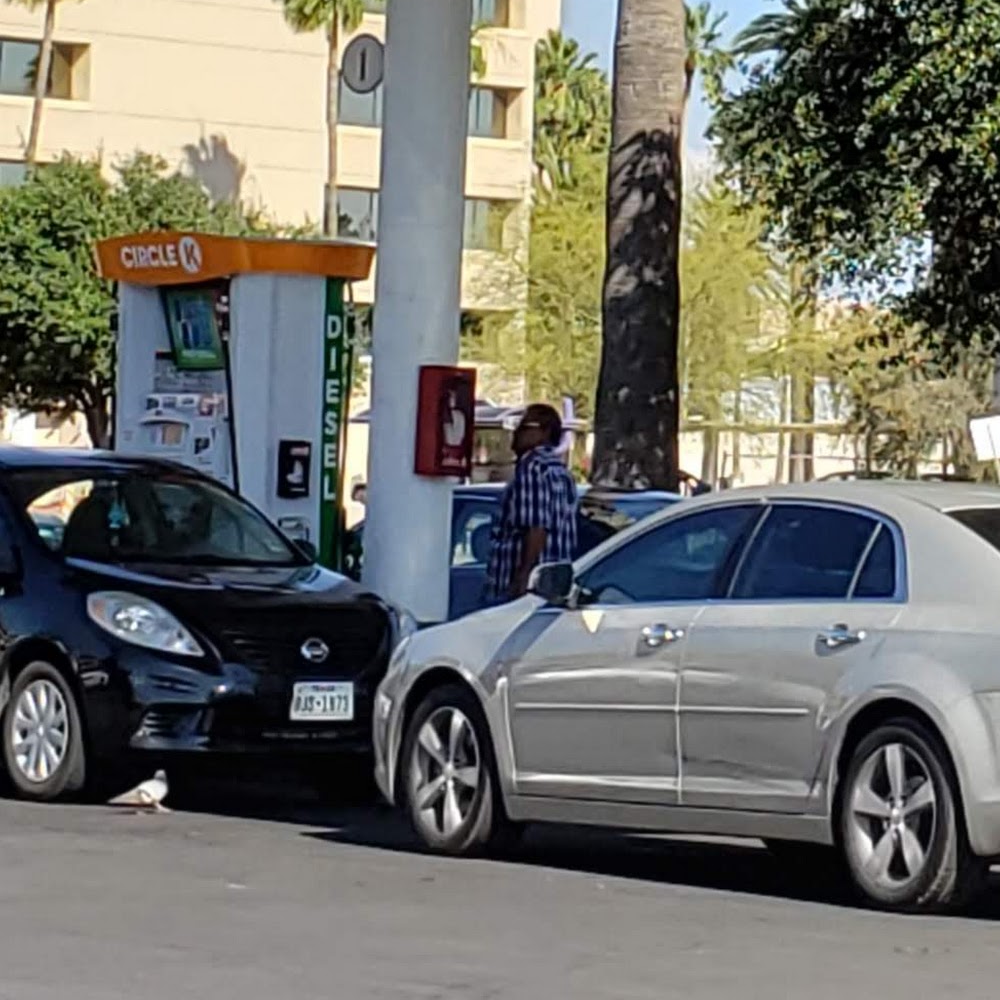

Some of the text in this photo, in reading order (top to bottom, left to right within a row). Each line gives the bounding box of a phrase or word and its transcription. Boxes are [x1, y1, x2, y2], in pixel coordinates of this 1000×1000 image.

[360, 47, 367, 82] 1
[120, 240, 202, 270] CIRCLE K
[323, 314, 342, 501] DIESEL
